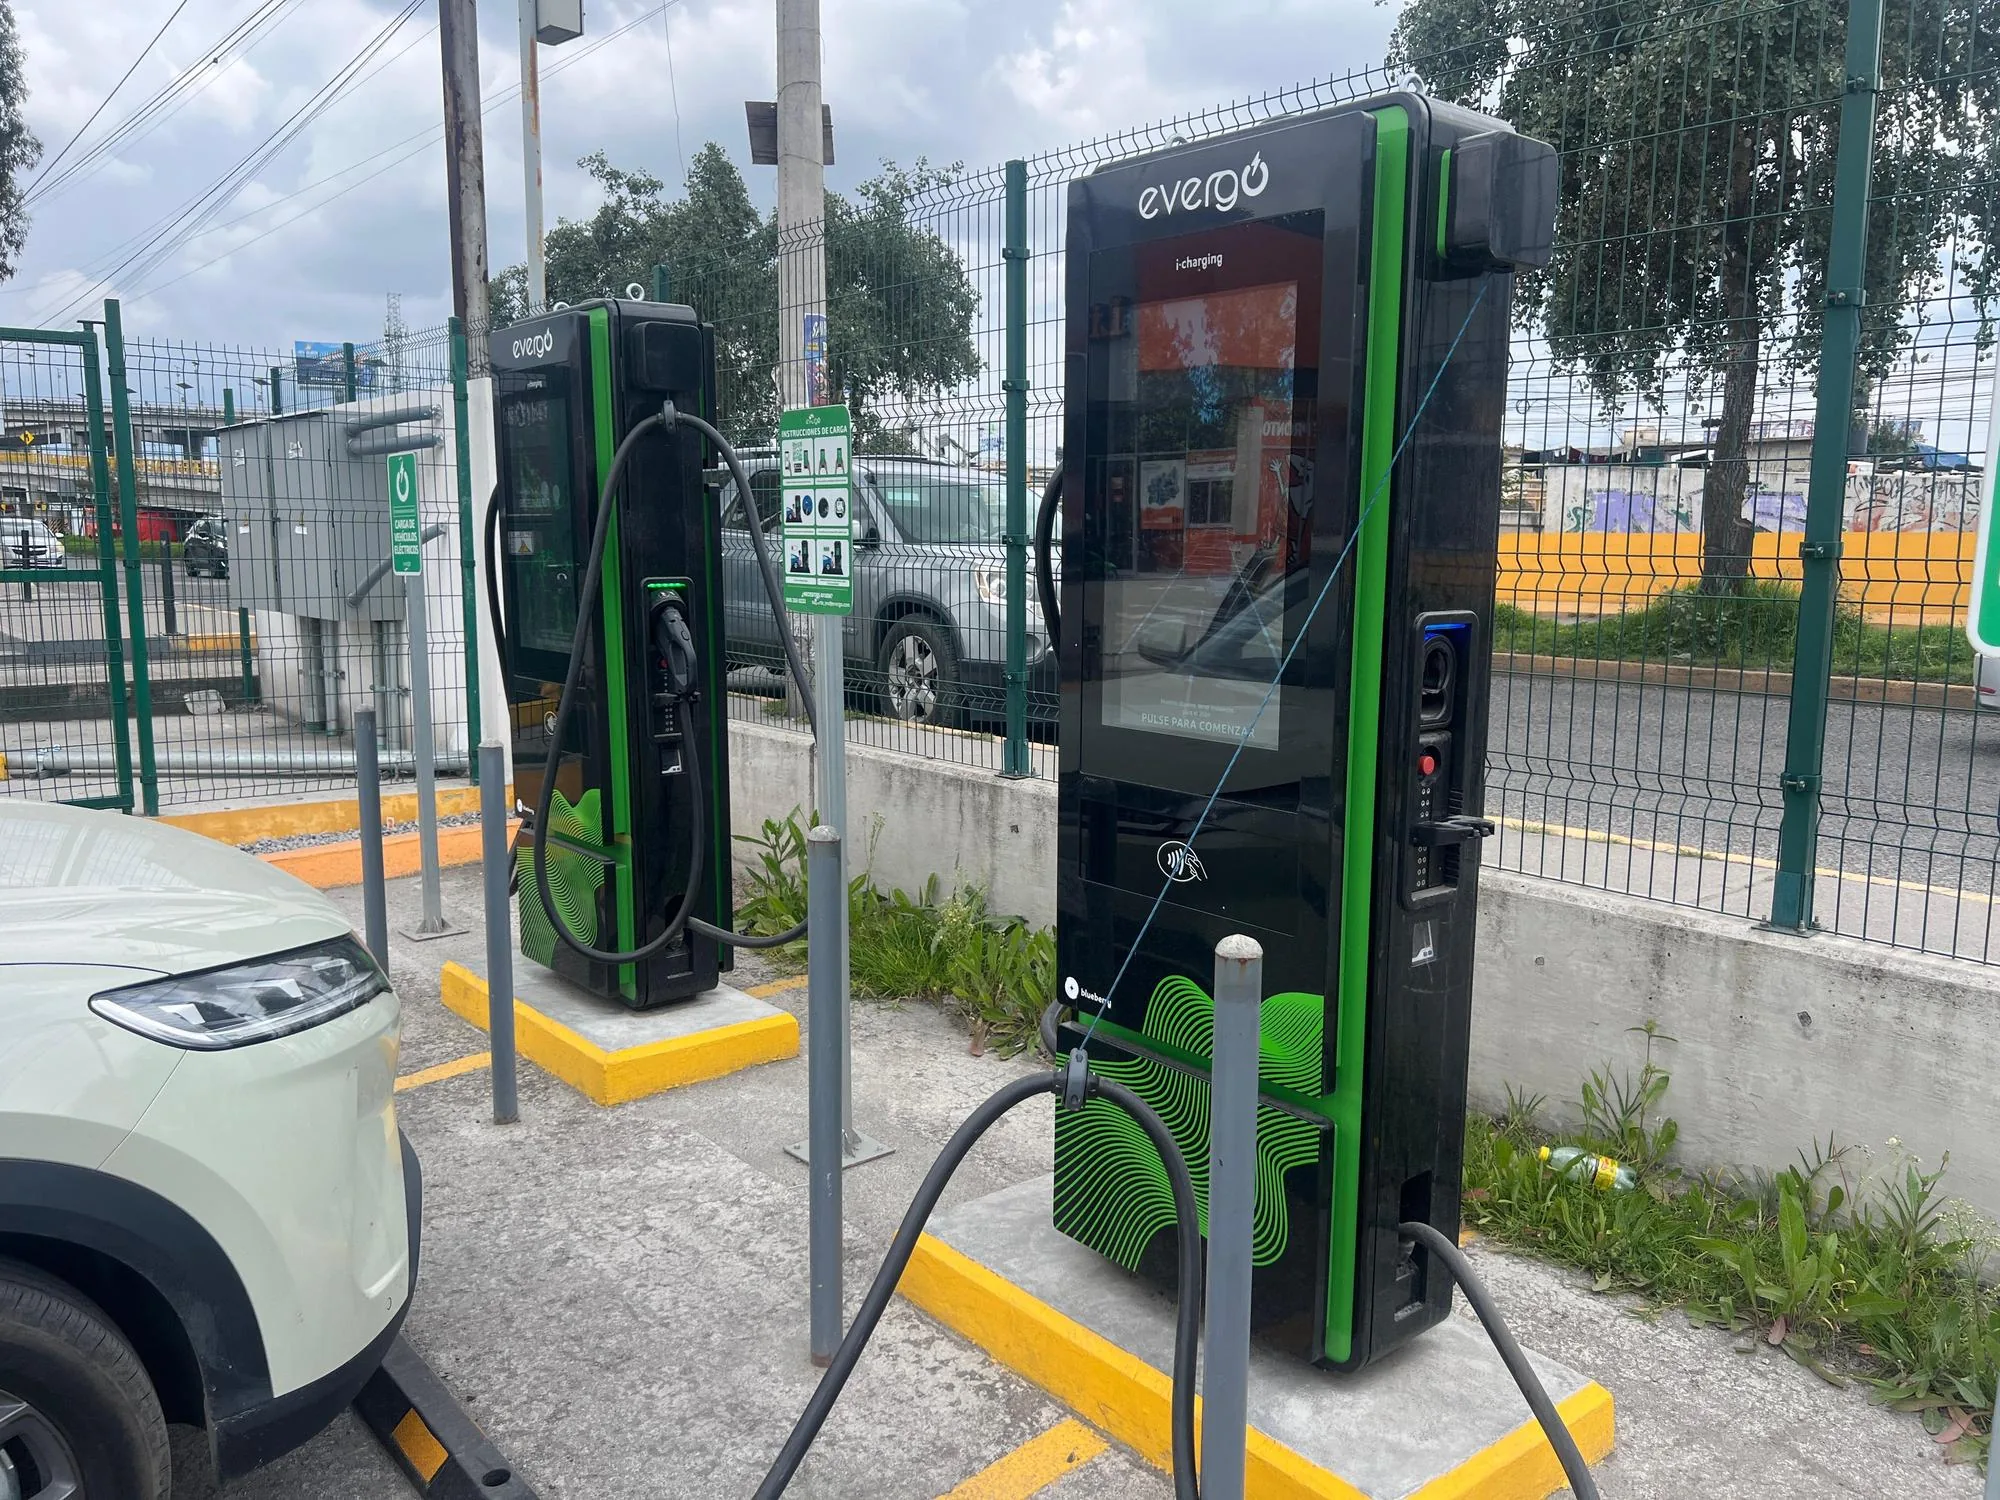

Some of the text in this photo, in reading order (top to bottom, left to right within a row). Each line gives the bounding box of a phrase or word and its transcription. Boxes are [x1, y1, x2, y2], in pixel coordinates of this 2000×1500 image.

[1139, 150, 1269, 220] evergo
[1176, 253, 1223, 271] i-charging
[512, 327, 553, 358] evergo
[781, 425, 848, 438] INSTRUCCIONES DE CARGA
[1141, 712, 1169, 726] PULSE
[1171, 717, 1197, 729] PARA
[1199, 720, 1256, 738] COMENZAR
